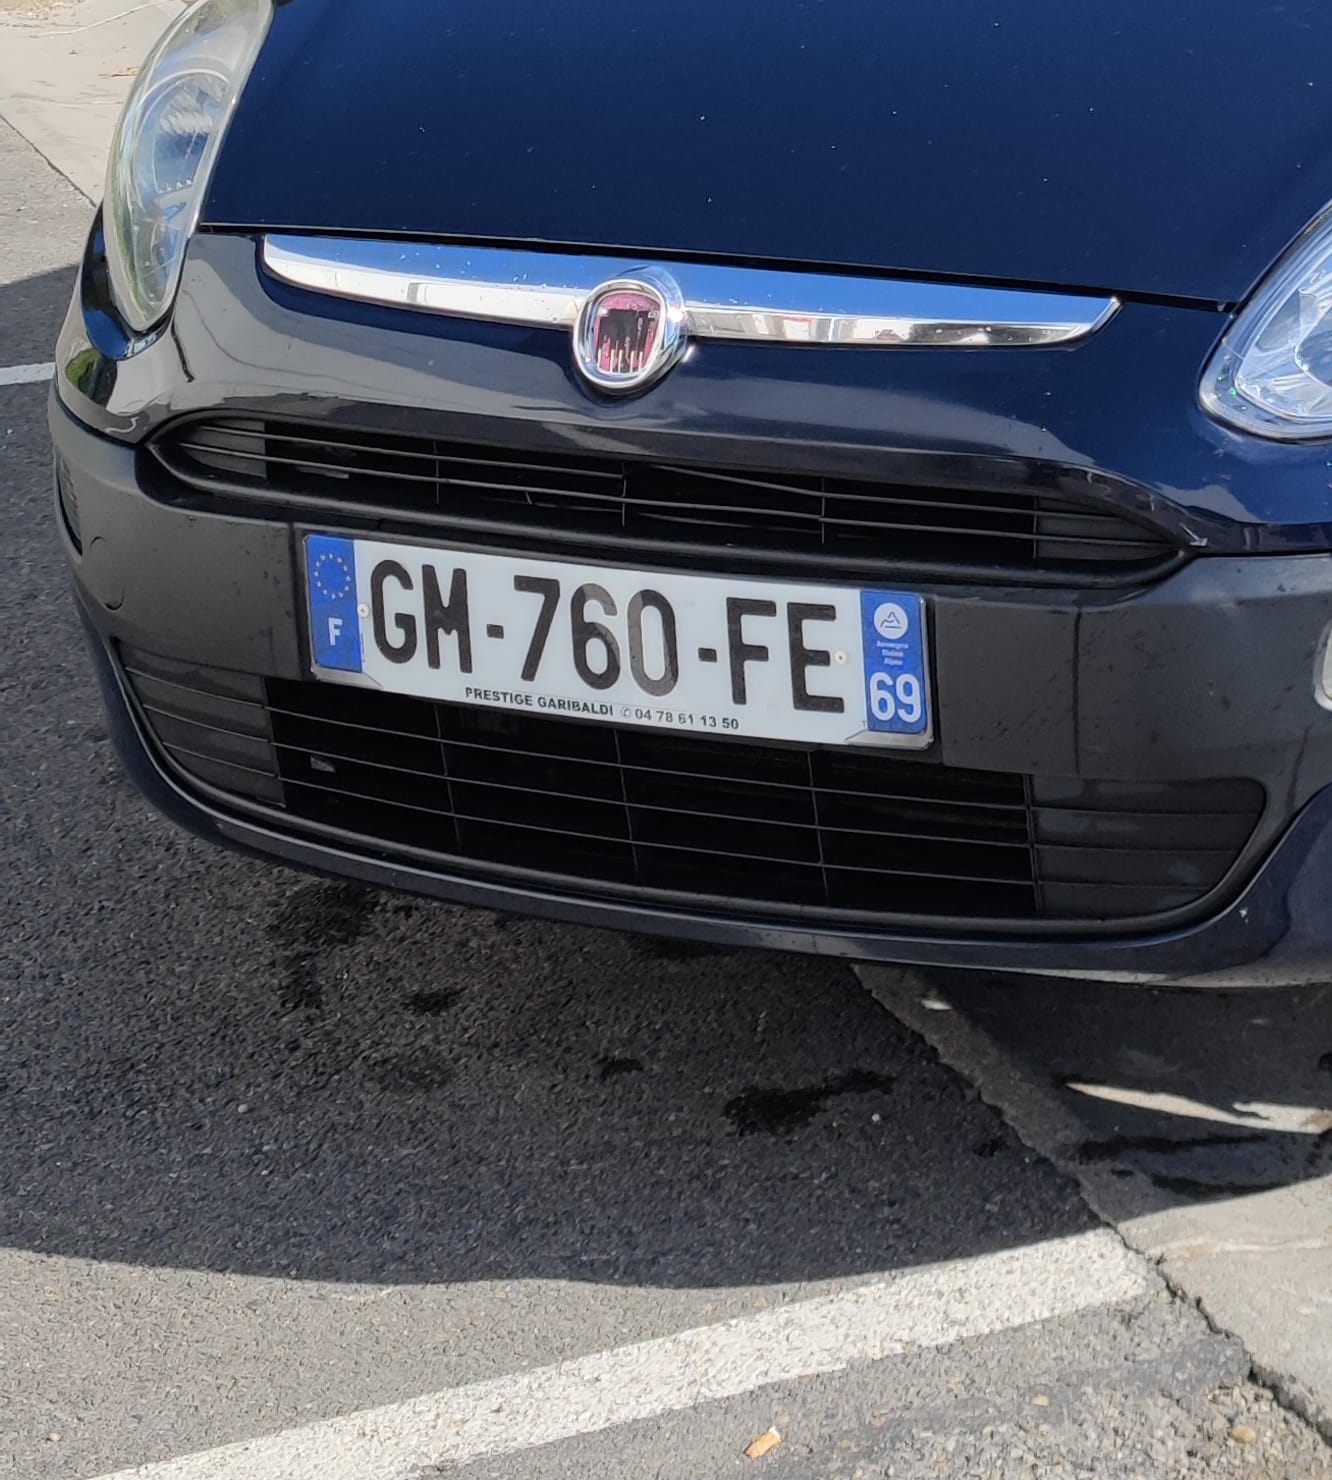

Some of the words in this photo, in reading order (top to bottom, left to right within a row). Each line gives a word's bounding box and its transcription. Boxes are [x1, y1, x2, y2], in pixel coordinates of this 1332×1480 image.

[327, 617, 342, 646] F
[370, 559, 845, 713] GM-760-FE
[465, 686, 533, 707] PRESTIGE
[537, 695, 614, 716] GARIBALDI
[634, 708, 652, 722] 04
[656, 710, 674, 724] 78
[700, 714, 717, 729] 13
[721, 717, 740, 731] 50
[869, 671, 922, 724] 69
